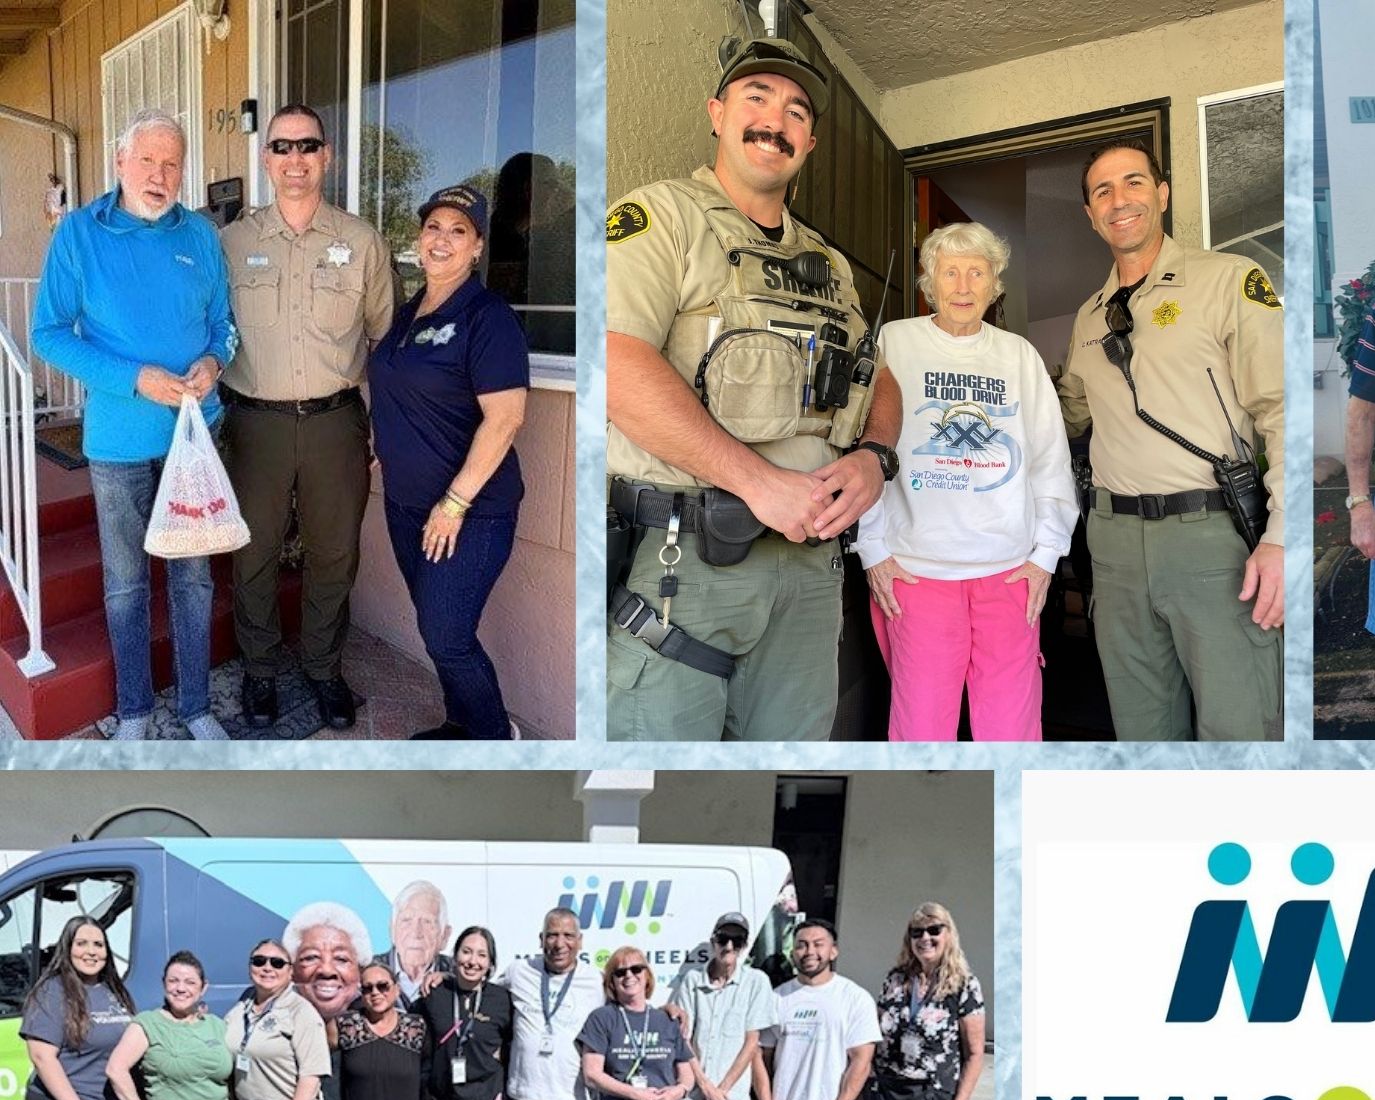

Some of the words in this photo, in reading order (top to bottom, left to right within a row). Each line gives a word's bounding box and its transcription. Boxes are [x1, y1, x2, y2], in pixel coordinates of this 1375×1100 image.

[624, 205, 643, 228] COUNTY
[606, 228, 626, 237] RIFF
[924, 371, 1006, 393] CHARGERS
[924, 385, 967, 401] BLOOD
[972, 389, 1007, 406] DRIVE
[934, 457, 946, 465] San
[947, 458, 963, 467] Diego
[910, 469, 924, 480] San
[924, 470, 945, 481] Diego
[945, 472, 970, 483] County
[925, 479, 946, 490] Credit
[947, 481, 968, 491] Union
[644, 950, 710, 965] EELS
